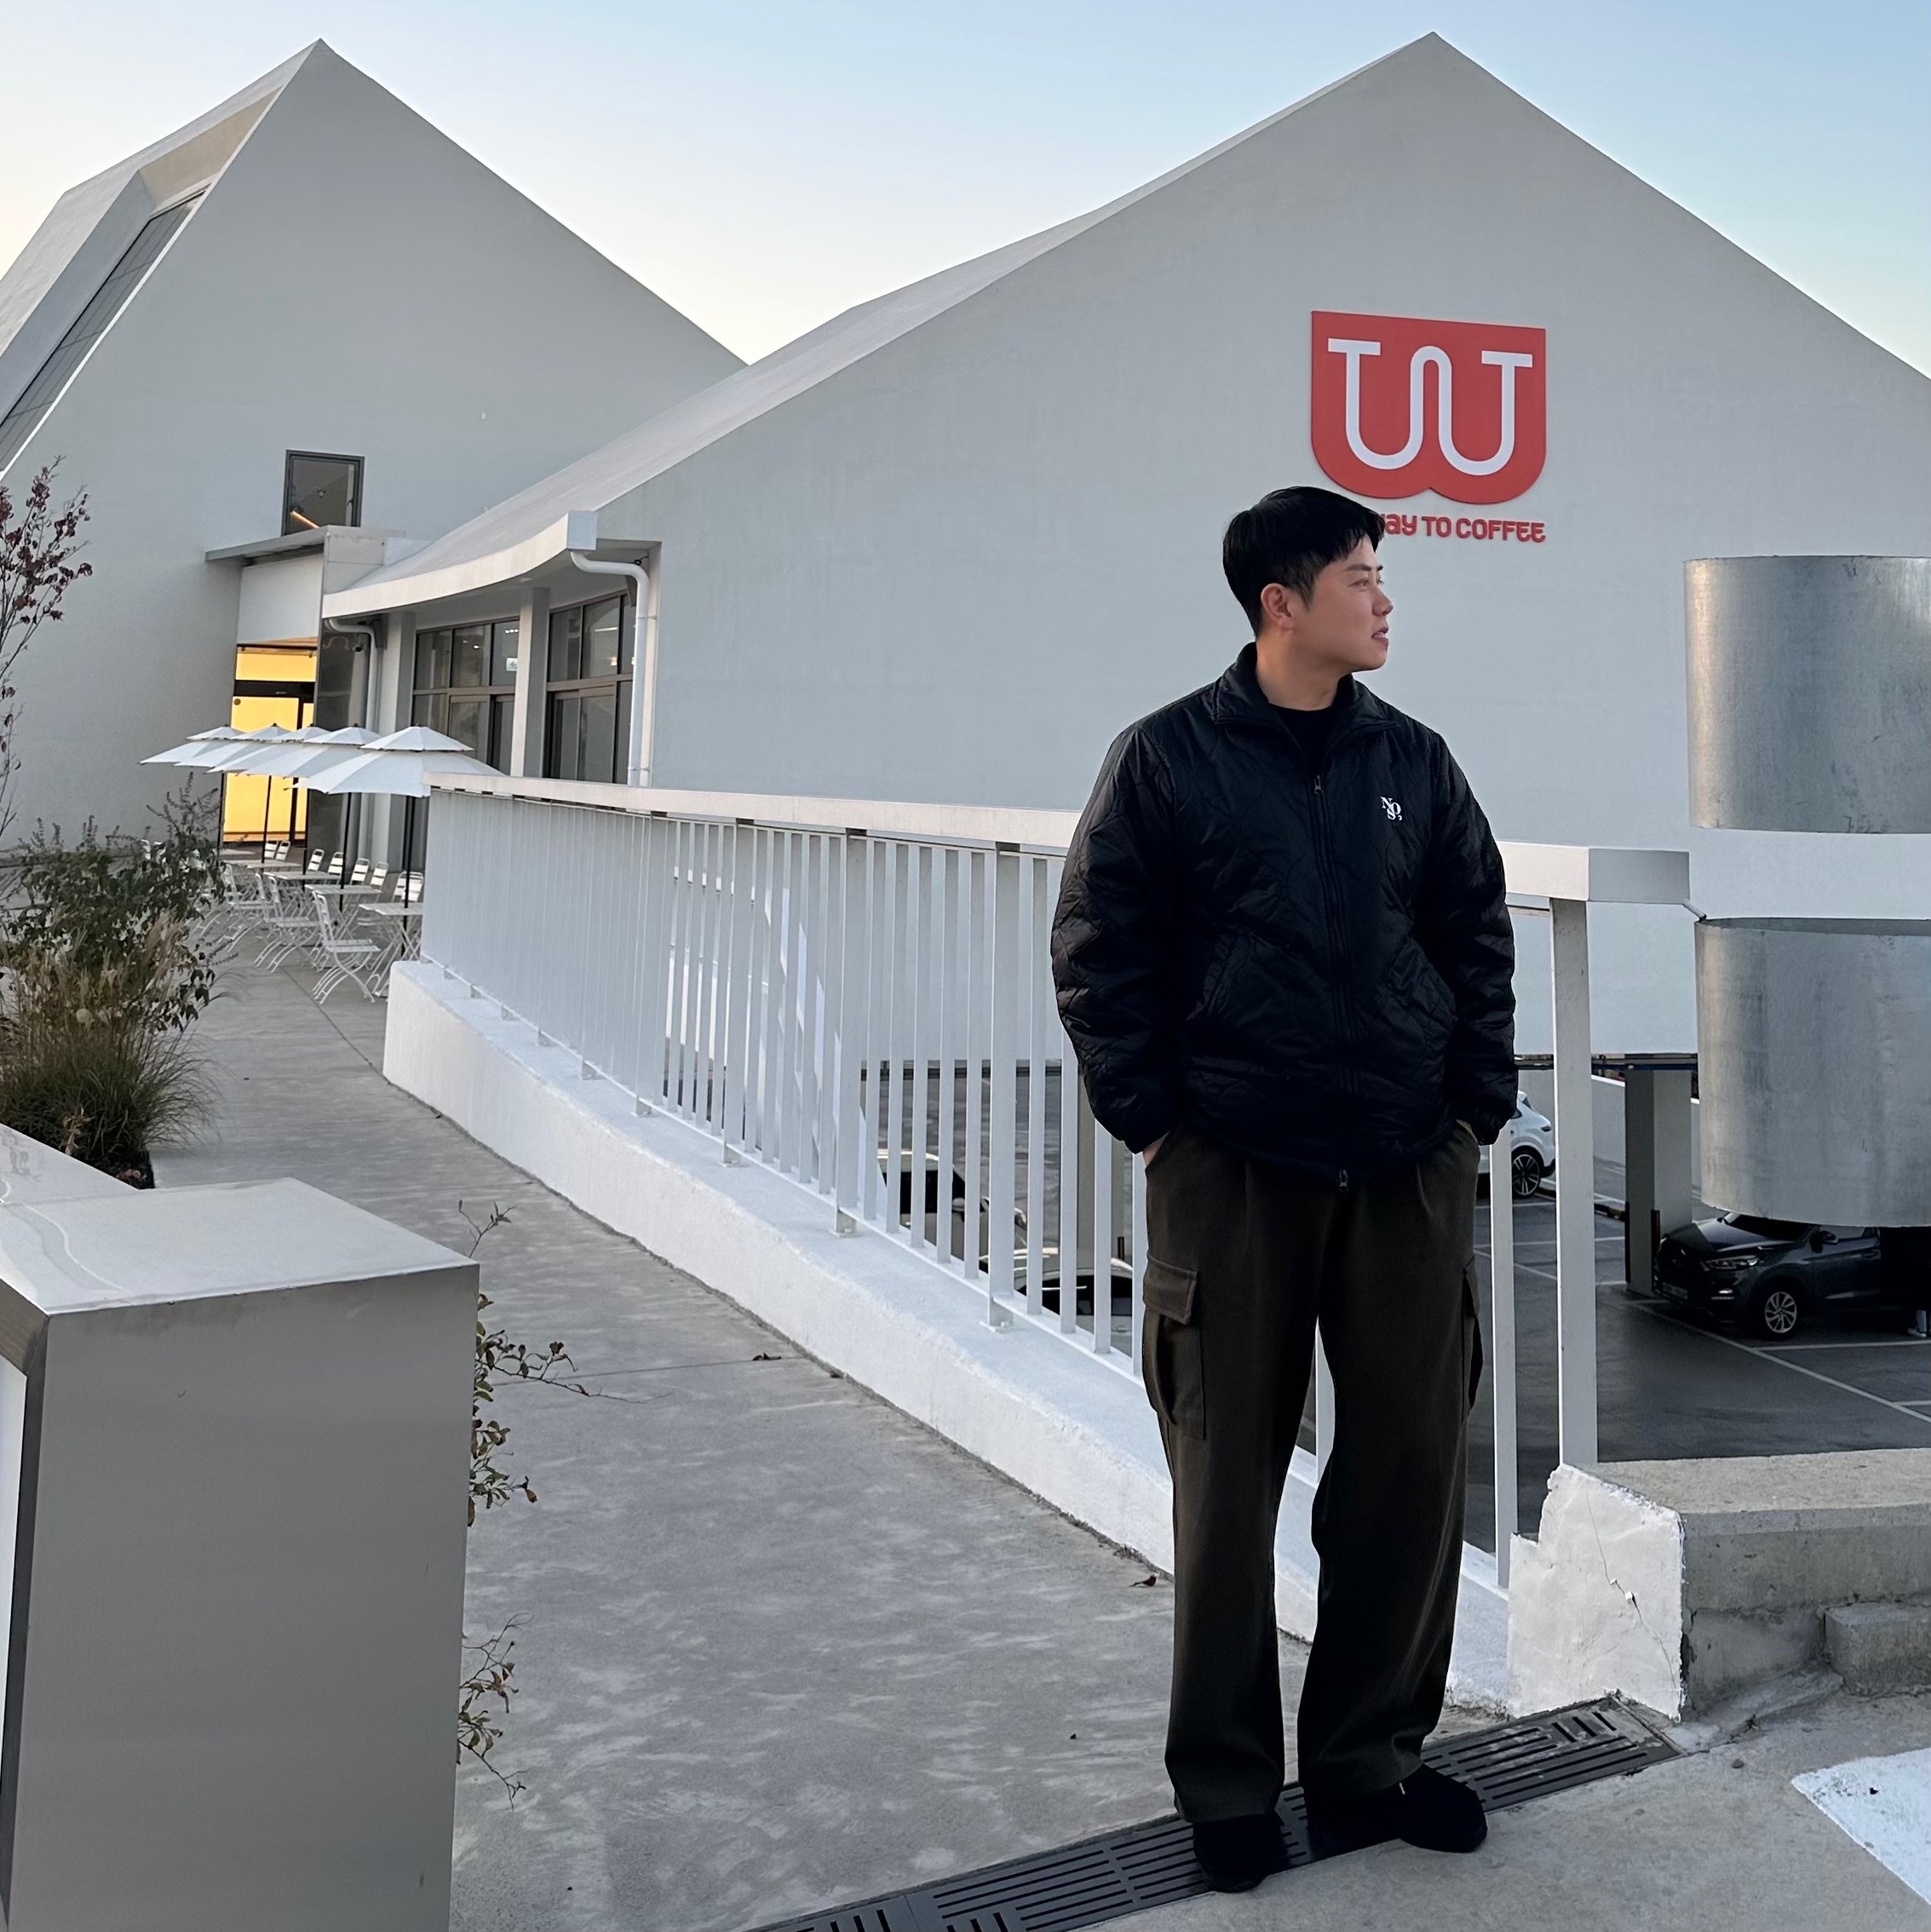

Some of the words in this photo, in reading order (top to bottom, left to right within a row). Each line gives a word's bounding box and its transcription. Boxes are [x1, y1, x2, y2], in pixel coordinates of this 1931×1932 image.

[1381, 513, 1417, 536] ay
[1421, 515, 1451, 538] TO
[1456, 518, 1546, 543] COFFEE
